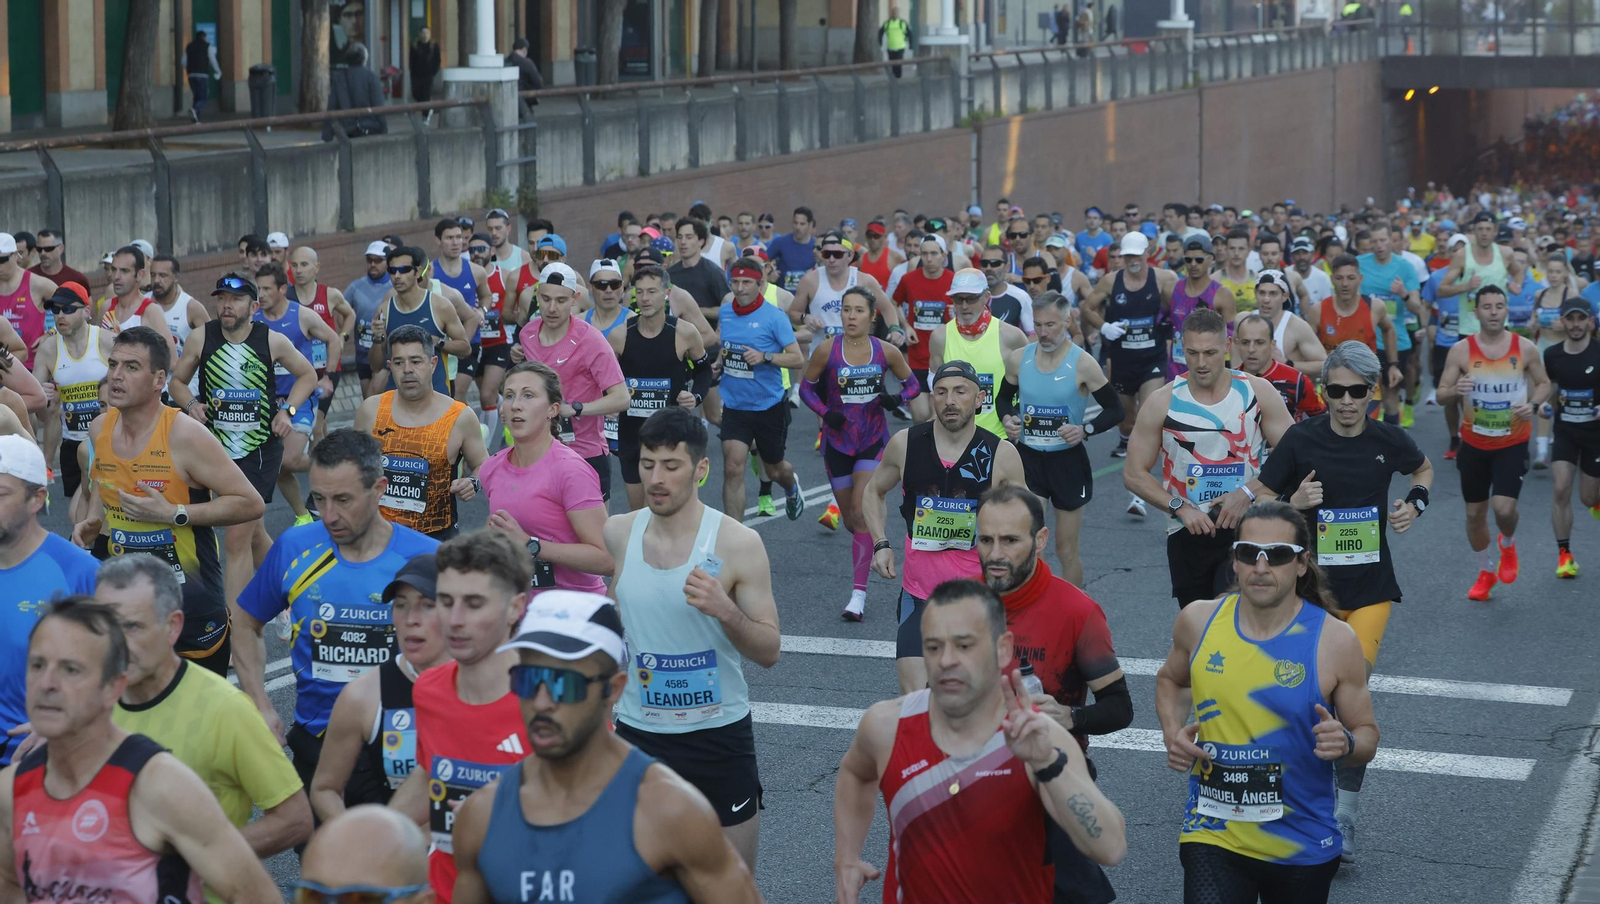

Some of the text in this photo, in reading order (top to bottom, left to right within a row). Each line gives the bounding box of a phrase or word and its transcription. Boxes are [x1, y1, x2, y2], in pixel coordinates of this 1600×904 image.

[725, 359, 749, 370] BARATA
[852, 366, 877, 374] ZURICH
[847, 385, 875, 395] NANNY
[631, 399, 666, 408] MORETTI
[218, 411, 255, 422] FABRICE
[392, 459, 425, 469] ZURICH
[392, 475, 411, 484] 3228
[384, 483, 421, 499] HACHO
[937, 501, 970, 510] ZURICH
[936, 516, 955, 525] 2253
[1338, 510, 1372, 520] ZURICH
[916, 525, 971, 539] RAMONES
[1339, 528, 1359, 537] 2255
[128, 534, 165, 543] ZURICH
[1335, 538, 1363, 551] HIRO
[340, 608, 388, 620] ZURICH
[341, 631, 367, 643] 4082
[318, 645, 390, 664] RICHARD
[661, 656, 707, 669] ZURICH
[665, 679, 689, 688] 4585
[646, 690, 714, 707] LEANDER
[1221, 749, 1269, 761] ZURICH
[1223, 772, 1249, 783] 3486
[1200, 784, 1283, 805] MIGUEL ÁNGEL
[520, 869, 575, 903] FAR
